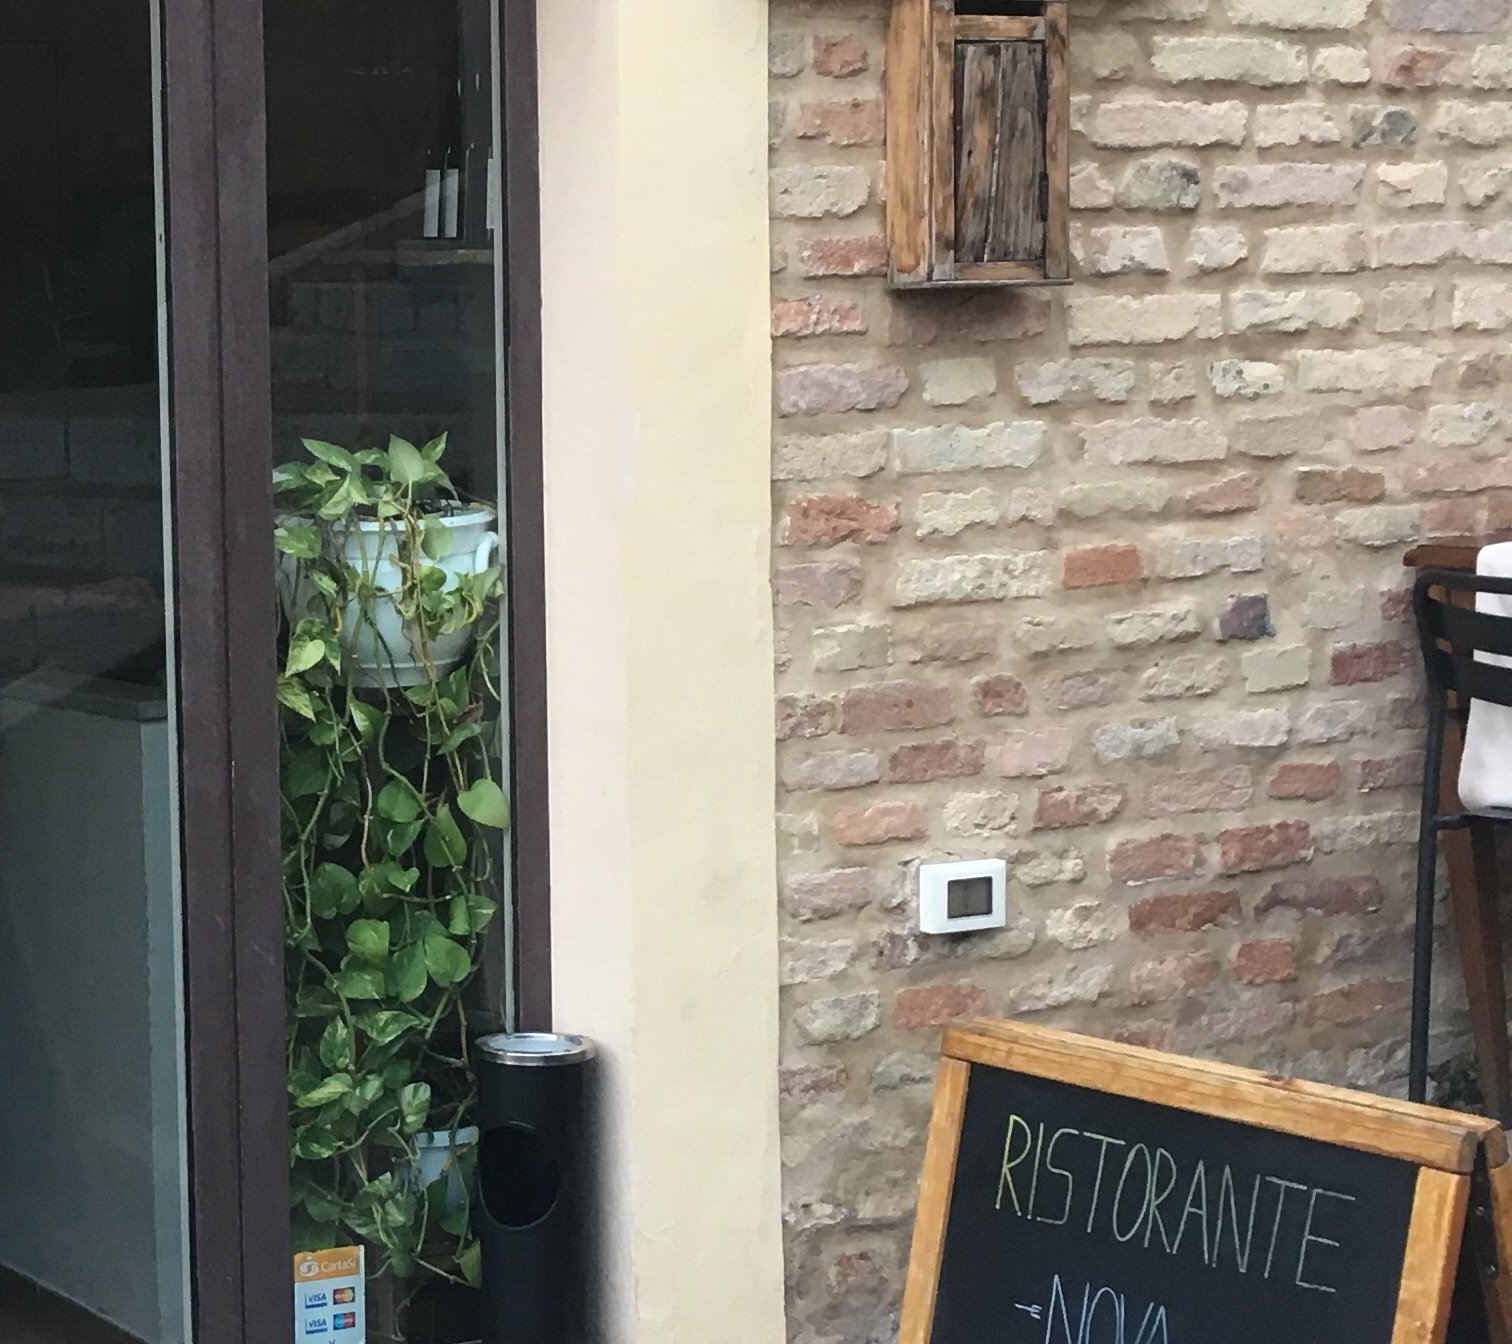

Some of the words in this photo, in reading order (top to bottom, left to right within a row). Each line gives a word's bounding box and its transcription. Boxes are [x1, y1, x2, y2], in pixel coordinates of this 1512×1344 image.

[995, 1113, 1356, 1293] RISTORANTE
[308, 1292, 327, 1302] VISA
[308, 1318, 327, 1328] VISA
